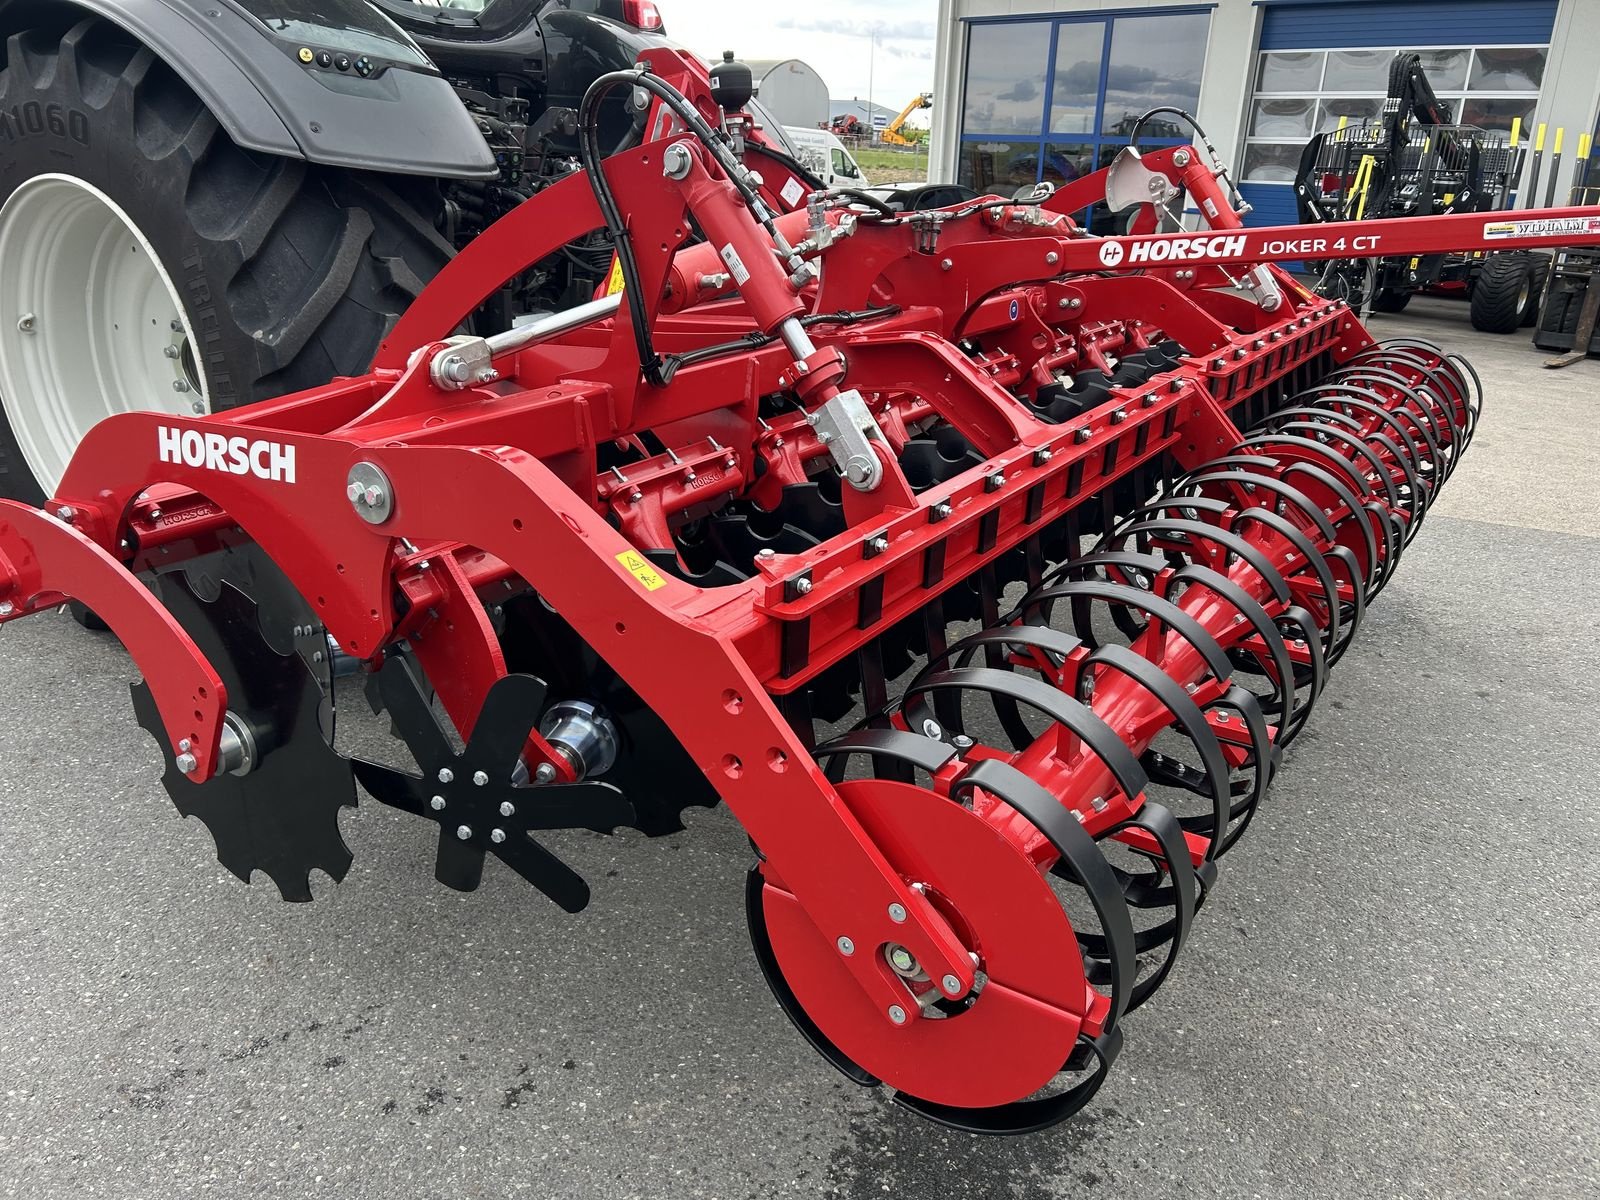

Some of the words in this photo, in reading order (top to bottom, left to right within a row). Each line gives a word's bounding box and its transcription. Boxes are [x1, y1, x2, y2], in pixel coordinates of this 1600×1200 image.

[1519, 221, 1584, 234] WIDHALM
[1128, 235, 1247, 262] HORSCH
[1259, 238, 1327, 255] JOKER
[1333, 237, 1346, 251] 4
[1352, 235, 1381, 250] CT
[157, 425, 296, 484] HORSCH
[163, 506, 213, 526] HORSCH
